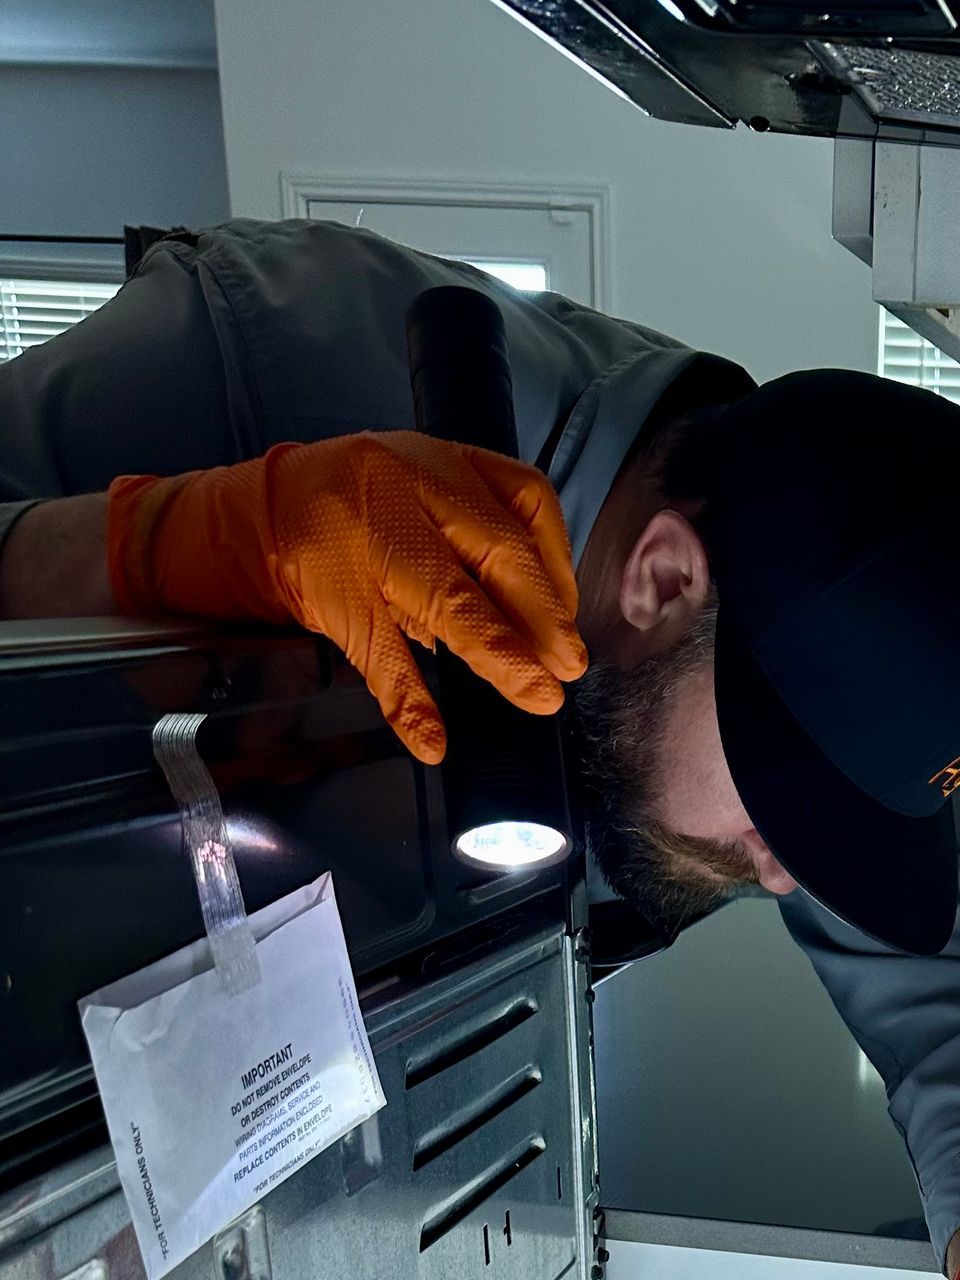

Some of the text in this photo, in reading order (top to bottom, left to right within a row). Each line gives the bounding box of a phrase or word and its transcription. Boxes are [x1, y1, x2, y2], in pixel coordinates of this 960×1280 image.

[231, 1053, 312, 1116] DO NOT REMOVE ENVELOPE
[241, 1043, 293, 1090] IMPORTANT
[234, 1126, 257, 1147] WIRING
[288, 1089, 310, 1111] SERVICE
[310, 1080, 321, 1094] AND
[239, 1142, 259, 1161] PARTS
[258, 1116, 295, 1148] INFORMATION
[295, 1094, 324, 1121] ENCLOSED
[240, 1072, 311, 1128] OR DESTROY CONTENTS
[233, 1154, 264, 1183] REPLACE
[264, 1131, 297, 1160] CONTENTS
[296, 1126, 304, 1138] IN
[304, 1104, 334, 1132] ENVELOPE
[268, 1152, 304, 1182] TECHNICIANS
[137, 1156, 162, 1231] TECHNICIANS
